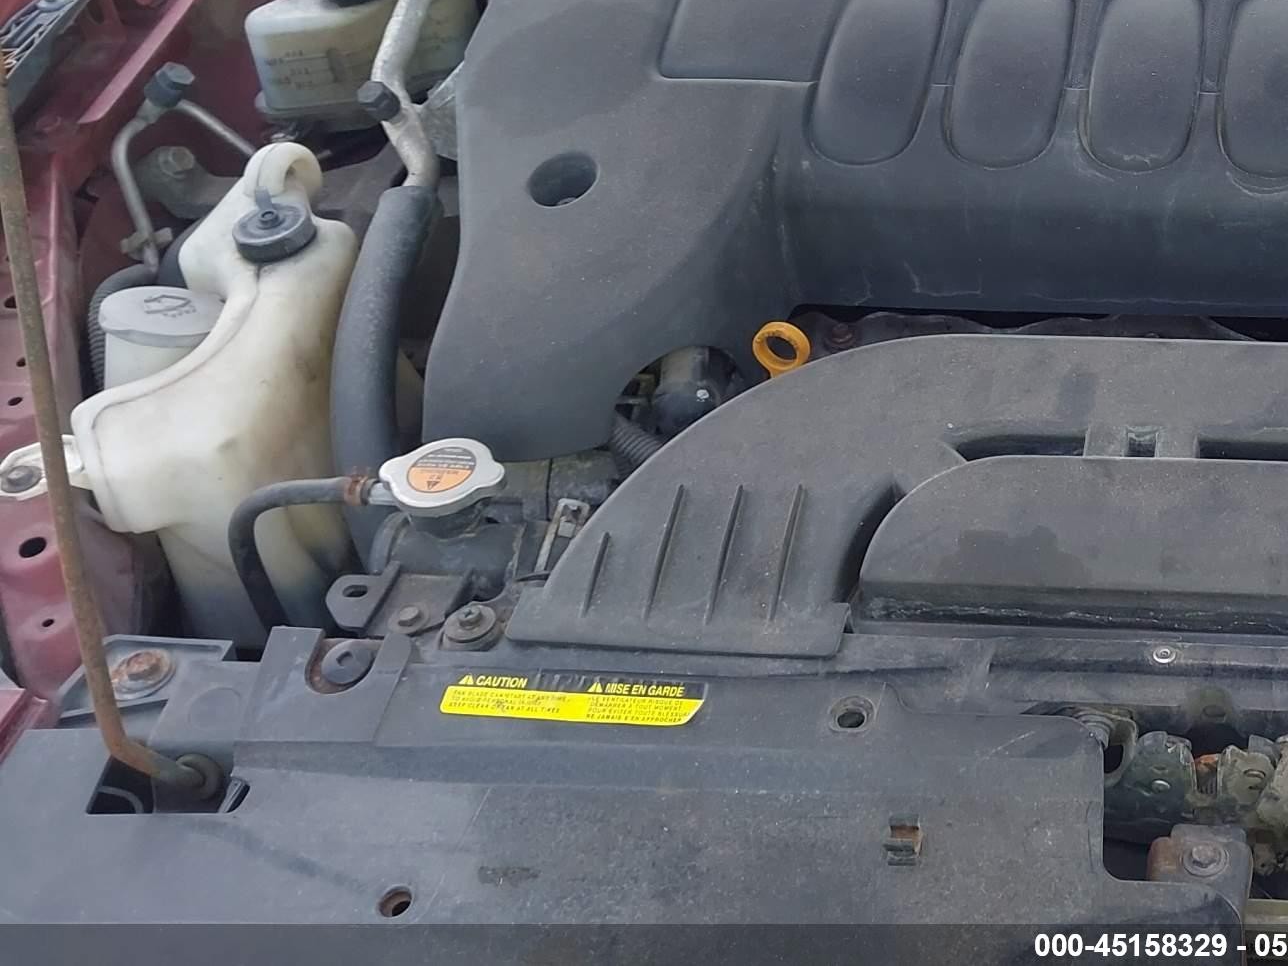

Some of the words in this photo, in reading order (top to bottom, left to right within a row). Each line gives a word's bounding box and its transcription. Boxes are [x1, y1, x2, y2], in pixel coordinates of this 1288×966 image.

[476, 675, 528, 688] CAUTION
[604, 682, 632, 695] MISE
[631, 684, 648, 696] EN
[647, 685, 686, 698] GARDE
